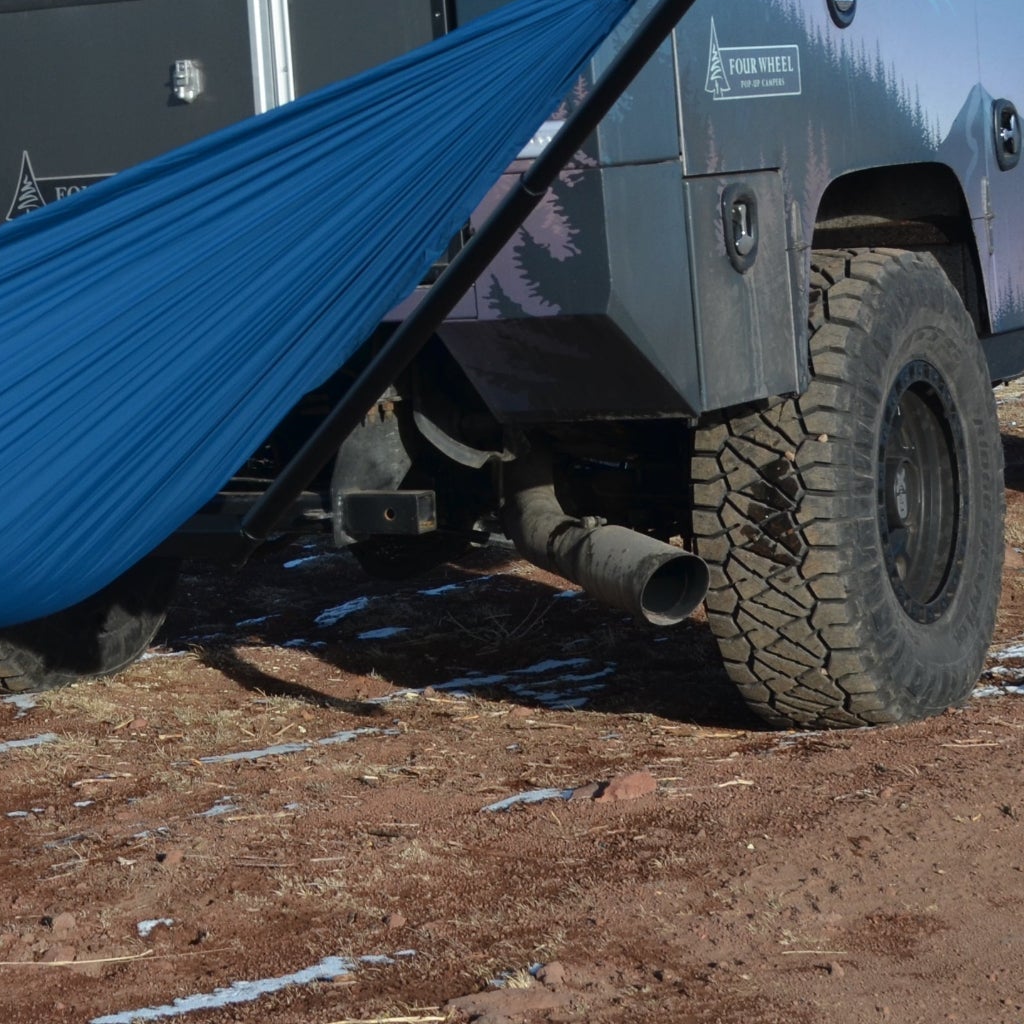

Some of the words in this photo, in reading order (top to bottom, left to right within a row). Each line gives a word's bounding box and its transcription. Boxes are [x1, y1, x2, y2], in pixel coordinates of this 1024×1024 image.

[729, 57, 758, 75] FOUR
[758, 56, 794, 73] WHEEL
[761, 78, 785, 87] CAMPERS
